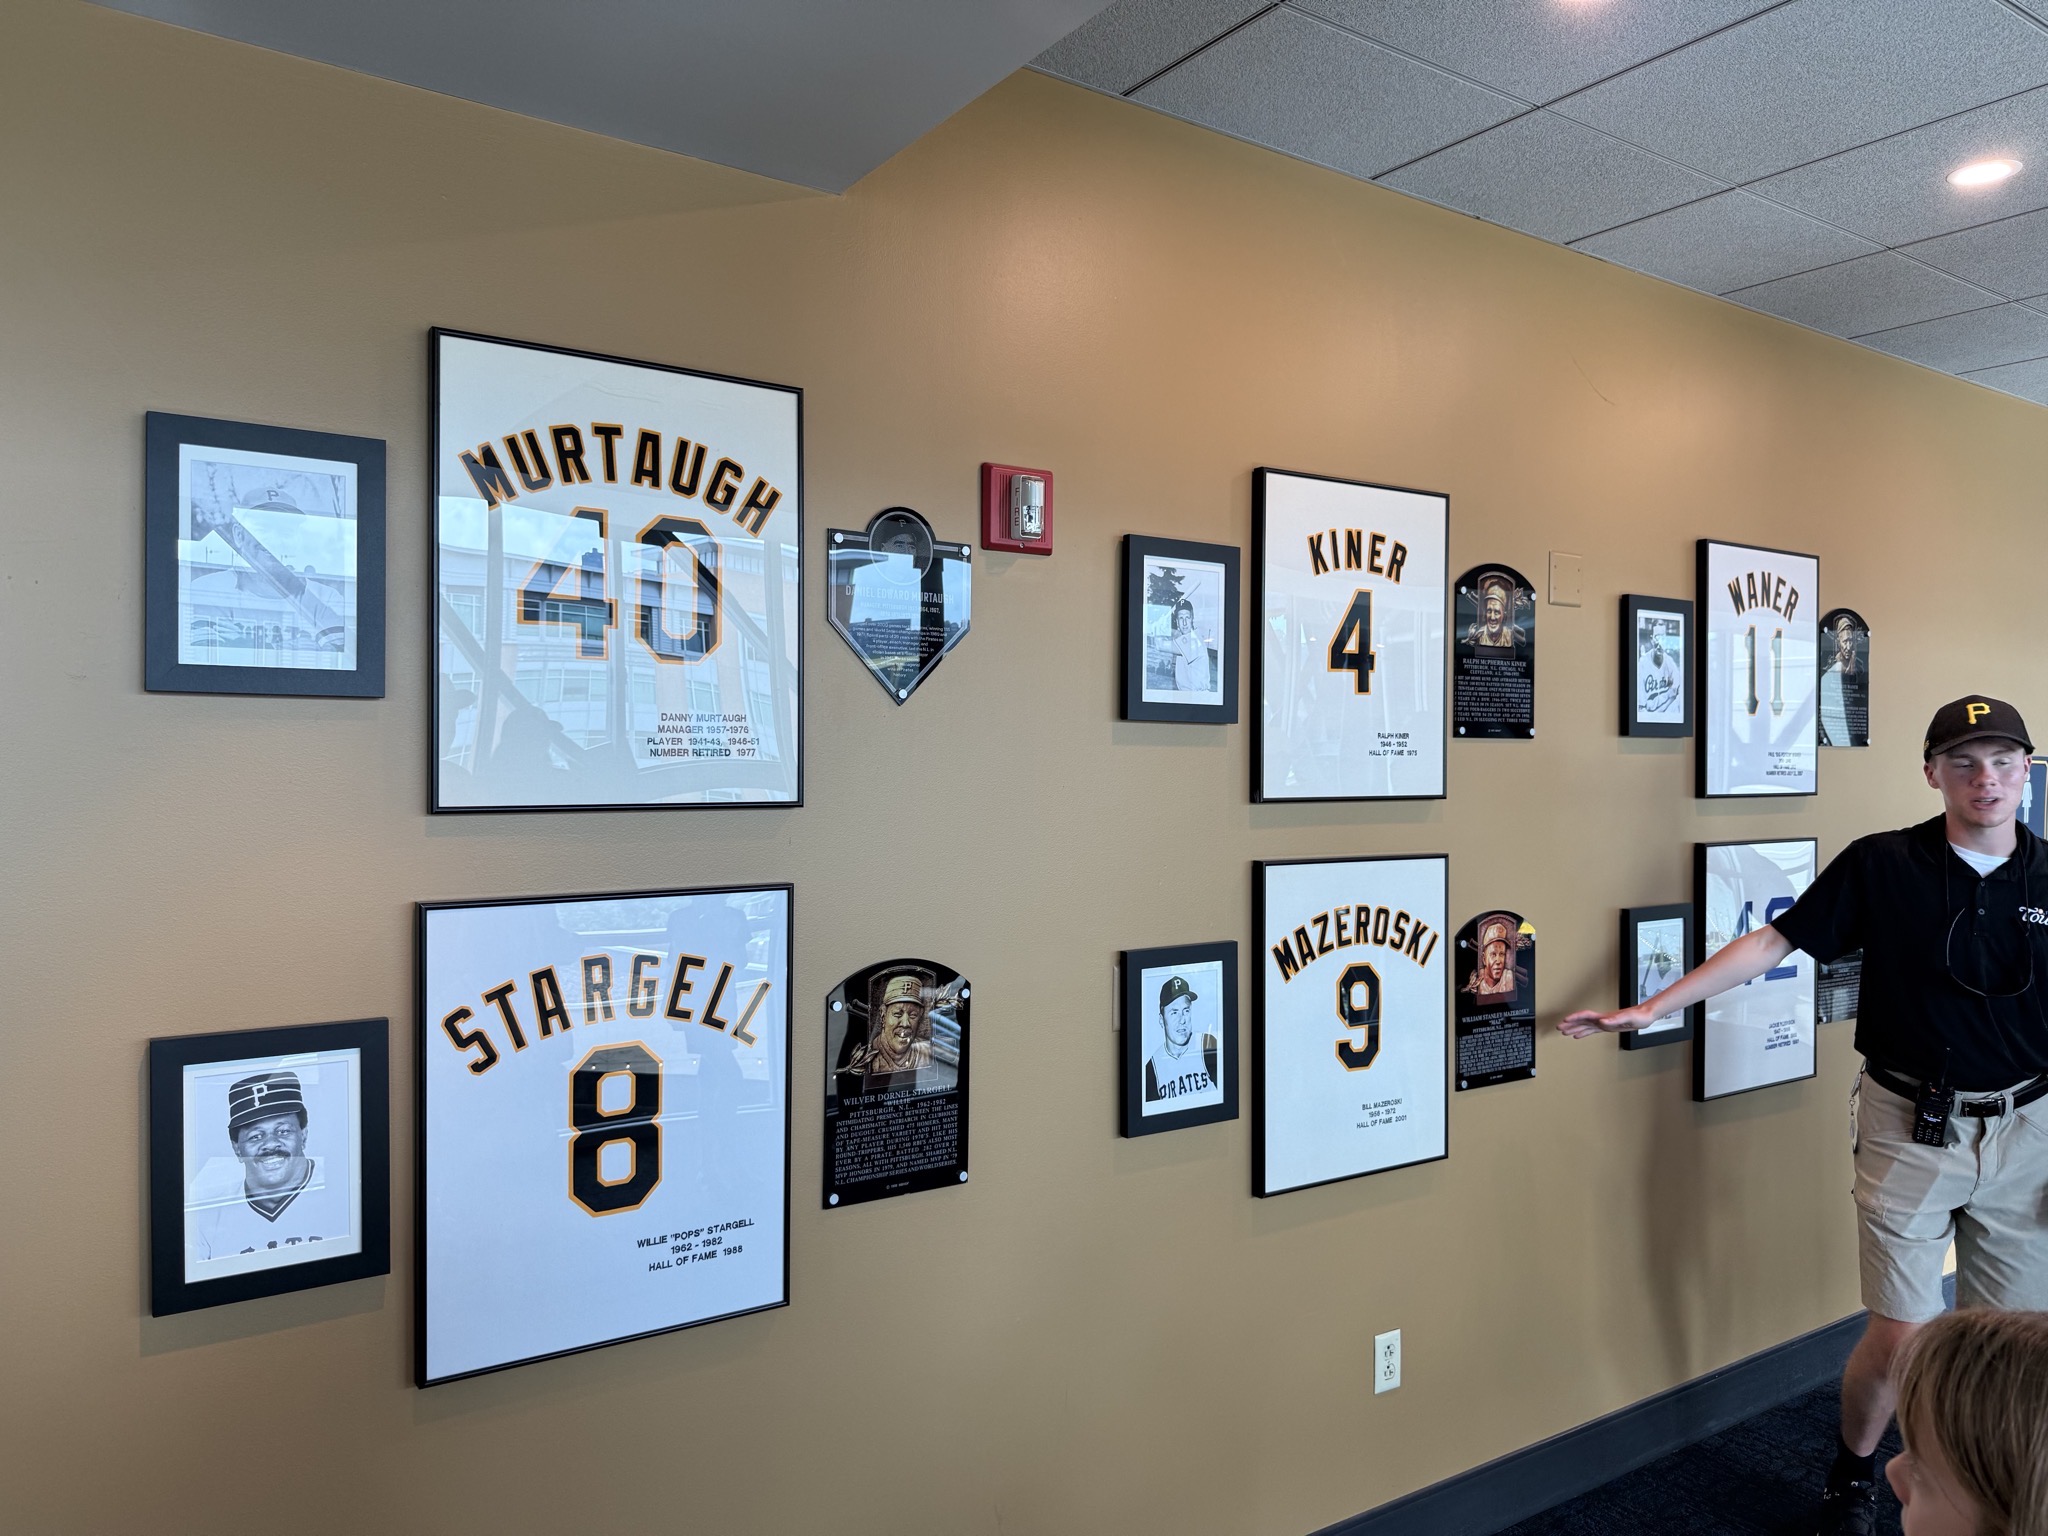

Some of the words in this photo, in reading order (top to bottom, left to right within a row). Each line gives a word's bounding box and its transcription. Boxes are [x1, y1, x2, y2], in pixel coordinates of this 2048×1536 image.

[458, 422, 783, 537] MURTAUGH
[1307, 528, 1408, 585] KINER
[517, 506, 723, 665] 40
[877, 587, 909, 600] EDWARD
[911, 590, 954, 605] MURTAUGH
[1727, 571, 1799, 624] WANER
[1327, 588, 1376, 695] 4
[1744, 624, 1785, 717] 11
[661, 713, 693, 722] DANNY
[696, 714, 746, 722] MURTAUGH
[1966, 702, 1991, 724] P
[657, 725, 704, 733] MANAGER
[707, 726, 749, 734] 1957-1976
[688, 738, 723, 746] 1941-43,
[650, 749, 689, 757] NUMBER
[692, 749, 731, 757] RETIRED
[1271, 904, 1439, 984] MAZEROSKI
[1173, 979, 1181, 990] P
[440, 953, 772, 1076] STARGELL
[1335, 962, 1382, 1072] 9
[252, 1083, 268, 1108] P
[843, 1095, 875, 1107] WILVER
[877, 1090, 911, 1101] DORNEL
[912, 1084, 953, 1096] STARGELL
[1159, 1072, 1209, 1100] PIRATES
[850, 1106, 895, 1119] PITTSBURGH,
[917, 1098, 946, 1108] 1962-1982
[1373, 1098, 1403, 1108] MAZEROSKI
[836, 1116, 874, 1127] INTIMIDATING
[877, 1111, 903, 1121] PRESENCE
[905, 1107, 930, 1116] BETWEEN
[850, 1121, 887, 1131] CHARISMATIC
[1356, 1121, 1369, 1129] HALL
[1370, 1119, 1378, 1127] OF
[1378, 1117, 1393, 1125] FAME
[568, 1040, 663, 1217] 8
[878, 1124, 905, 1134] CRUSHED
[861, 1140, 884, 1149] PLAYER
[836, 1158, 852, 1166] EVER
[849, 1168, 872, 1177] HONORS
[874, 1158, 889, 1166] WITH
[637, 1235, 668, 1248] WILLIE
[670, 1228, 705, 1241] "POPS"
[707, 1218, 755, 1235] STARGELL
[670, 1242, 693, 1254] 1962
[701, 1236, 723, 1248] 1982
[648, 1260, 673, 1272] HALL
[675, 1255, 689, 1266] OF
[691, 1250, 717, 1263] FAME
[722, 1245, 743, 1256] 1988
